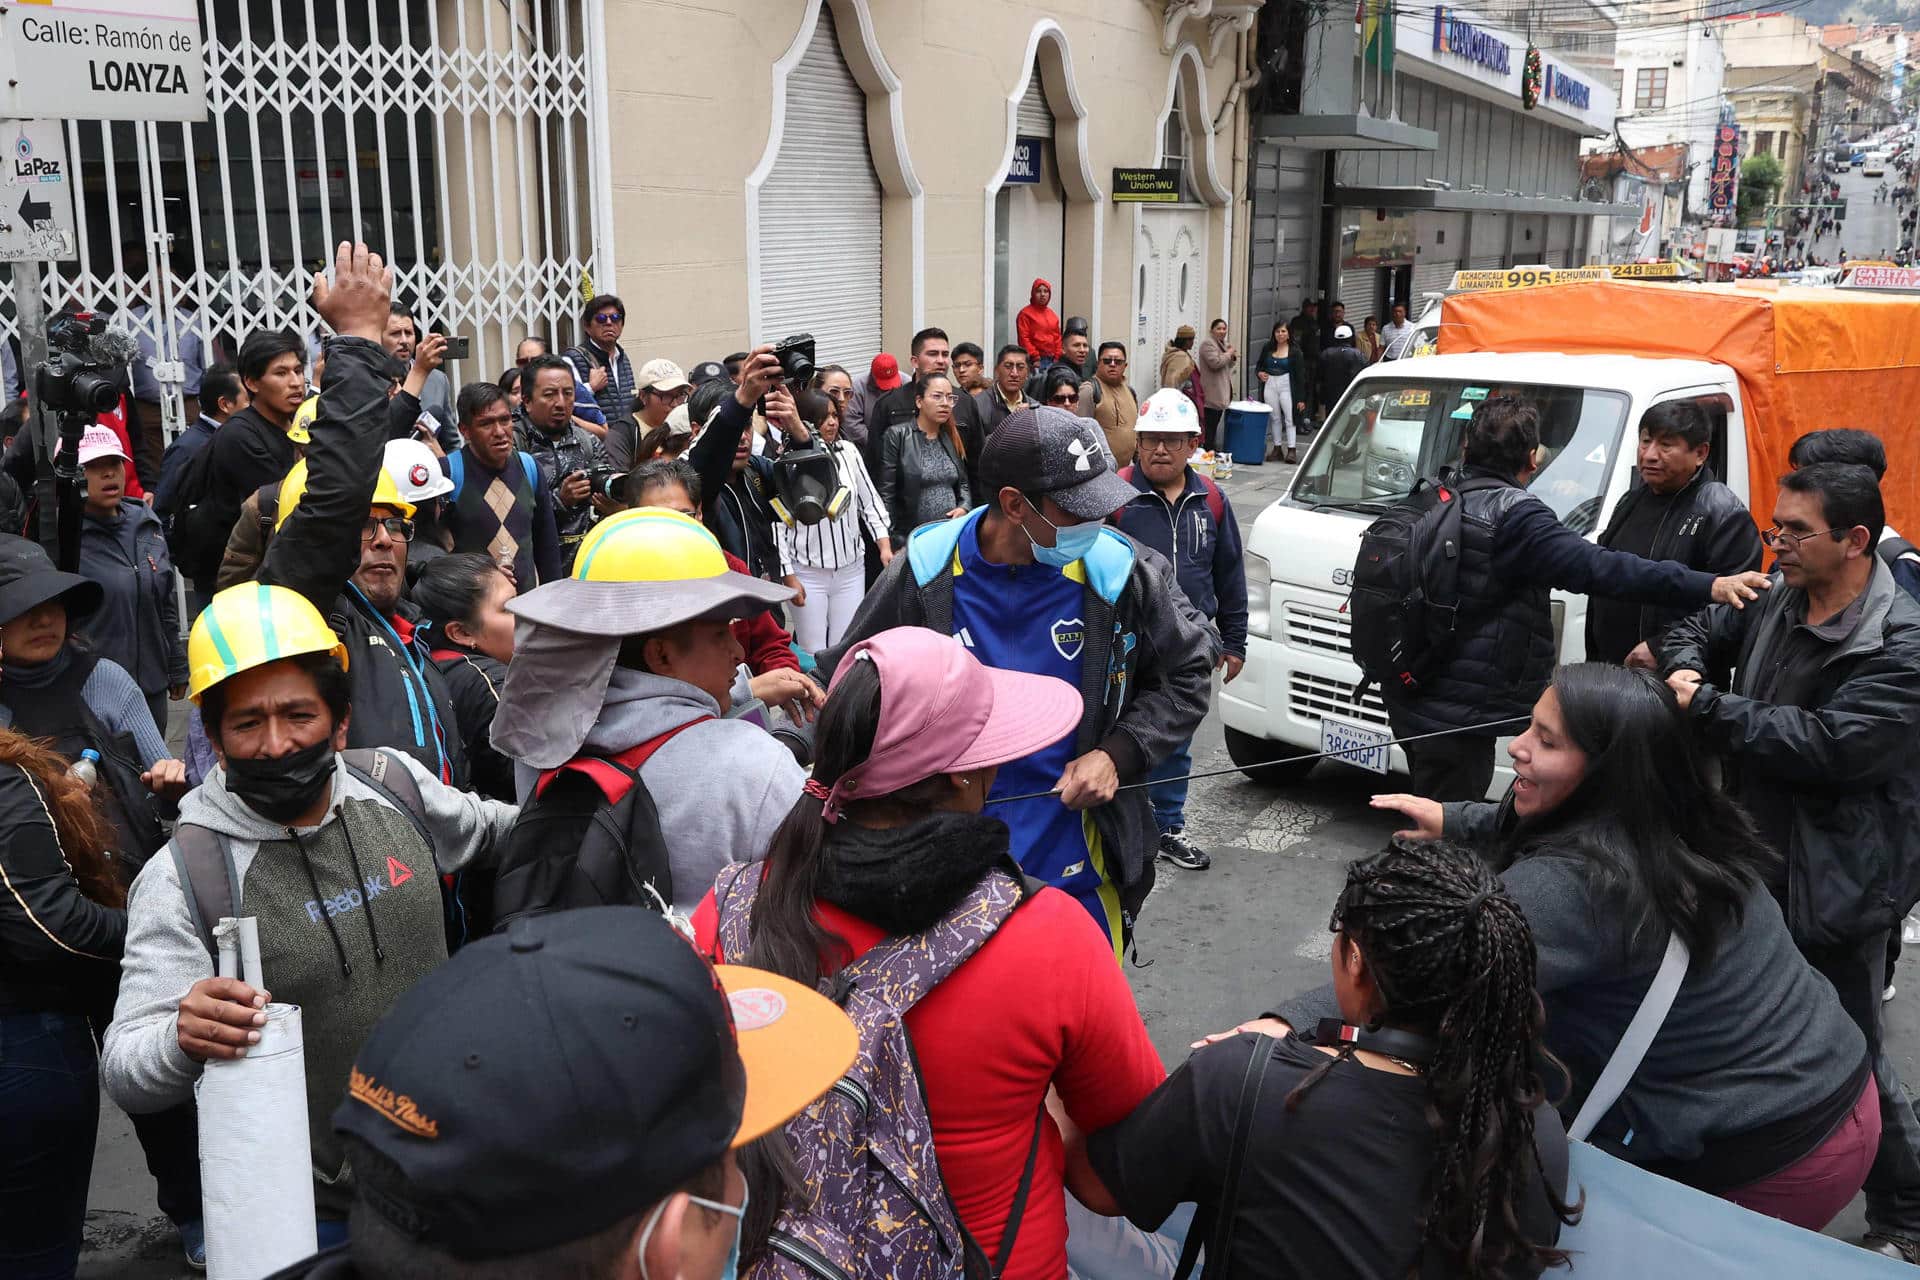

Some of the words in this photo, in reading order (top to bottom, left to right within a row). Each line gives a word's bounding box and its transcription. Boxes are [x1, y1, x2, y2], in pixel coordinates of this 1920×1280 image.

[22, 17, 90, 45] Calle:
[95, 24, 164, 50] Ramón
[169, 30, 192, 52] de
[88, 60, 189, 94] LOAYZA
[1014, 145, 1030, 161] NCO
[1009, 160, 1030, 176] NION
[1119, 172, 1156, 181] Western
[1130, 181, 1156, 190] Union
[1461, 271, 1504, 280] ACHACHICALA
[1555, 270, 1601, 280] ACHUMANI
[1612, 265, 1642, 276] 248
[1459, 280, 1503, 289] LIMANIPATA
[1507, 271, 1551, 288] 995
[1339, 727, 1372, 742] BOLIVIA
